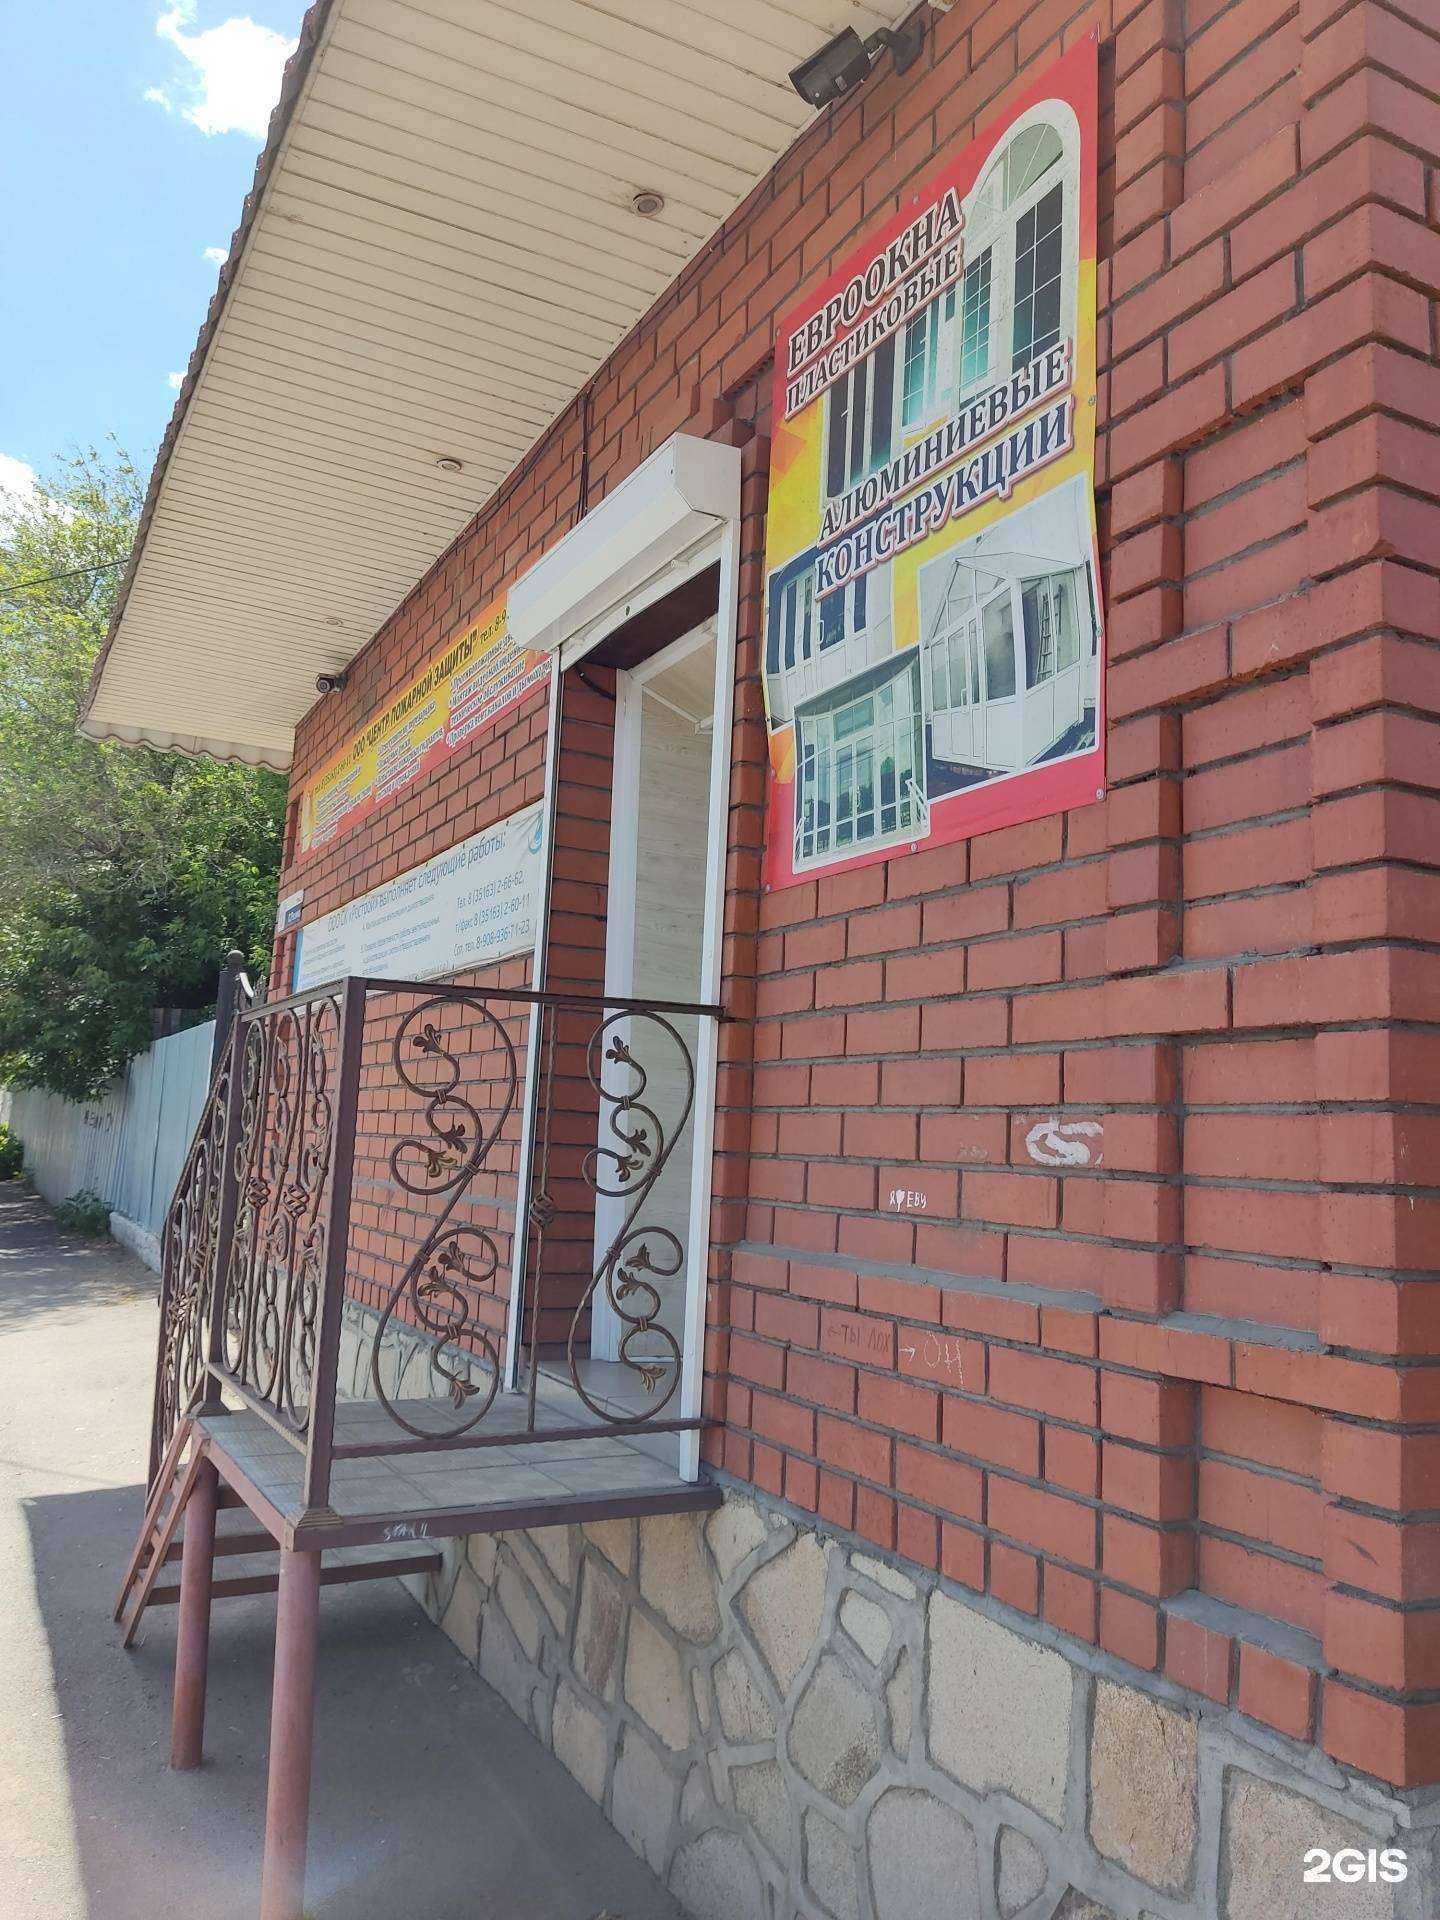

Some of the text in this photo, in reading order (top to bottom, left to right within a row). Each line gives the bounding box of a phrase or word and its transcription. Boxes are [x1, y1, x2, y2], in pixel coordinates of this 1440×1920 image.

[786, 241, 962, 415] ПЛАСТИКОВЫЕ
[789, 189, 963, 373] ЕВРООКНА
[815, 401, 1068, 596] КОНСТРУКЦИИ
[820, 343, 1068, 541] АЛЮМИНИЕВЫЕ
[390, 667, 433, 725] ПОЖАРНОЙ
[434, 628, 478, 687] ЗАЩИТЫ"
[418, 853, 466, 889] следующие
[467, 832, 506, 870] работы:
